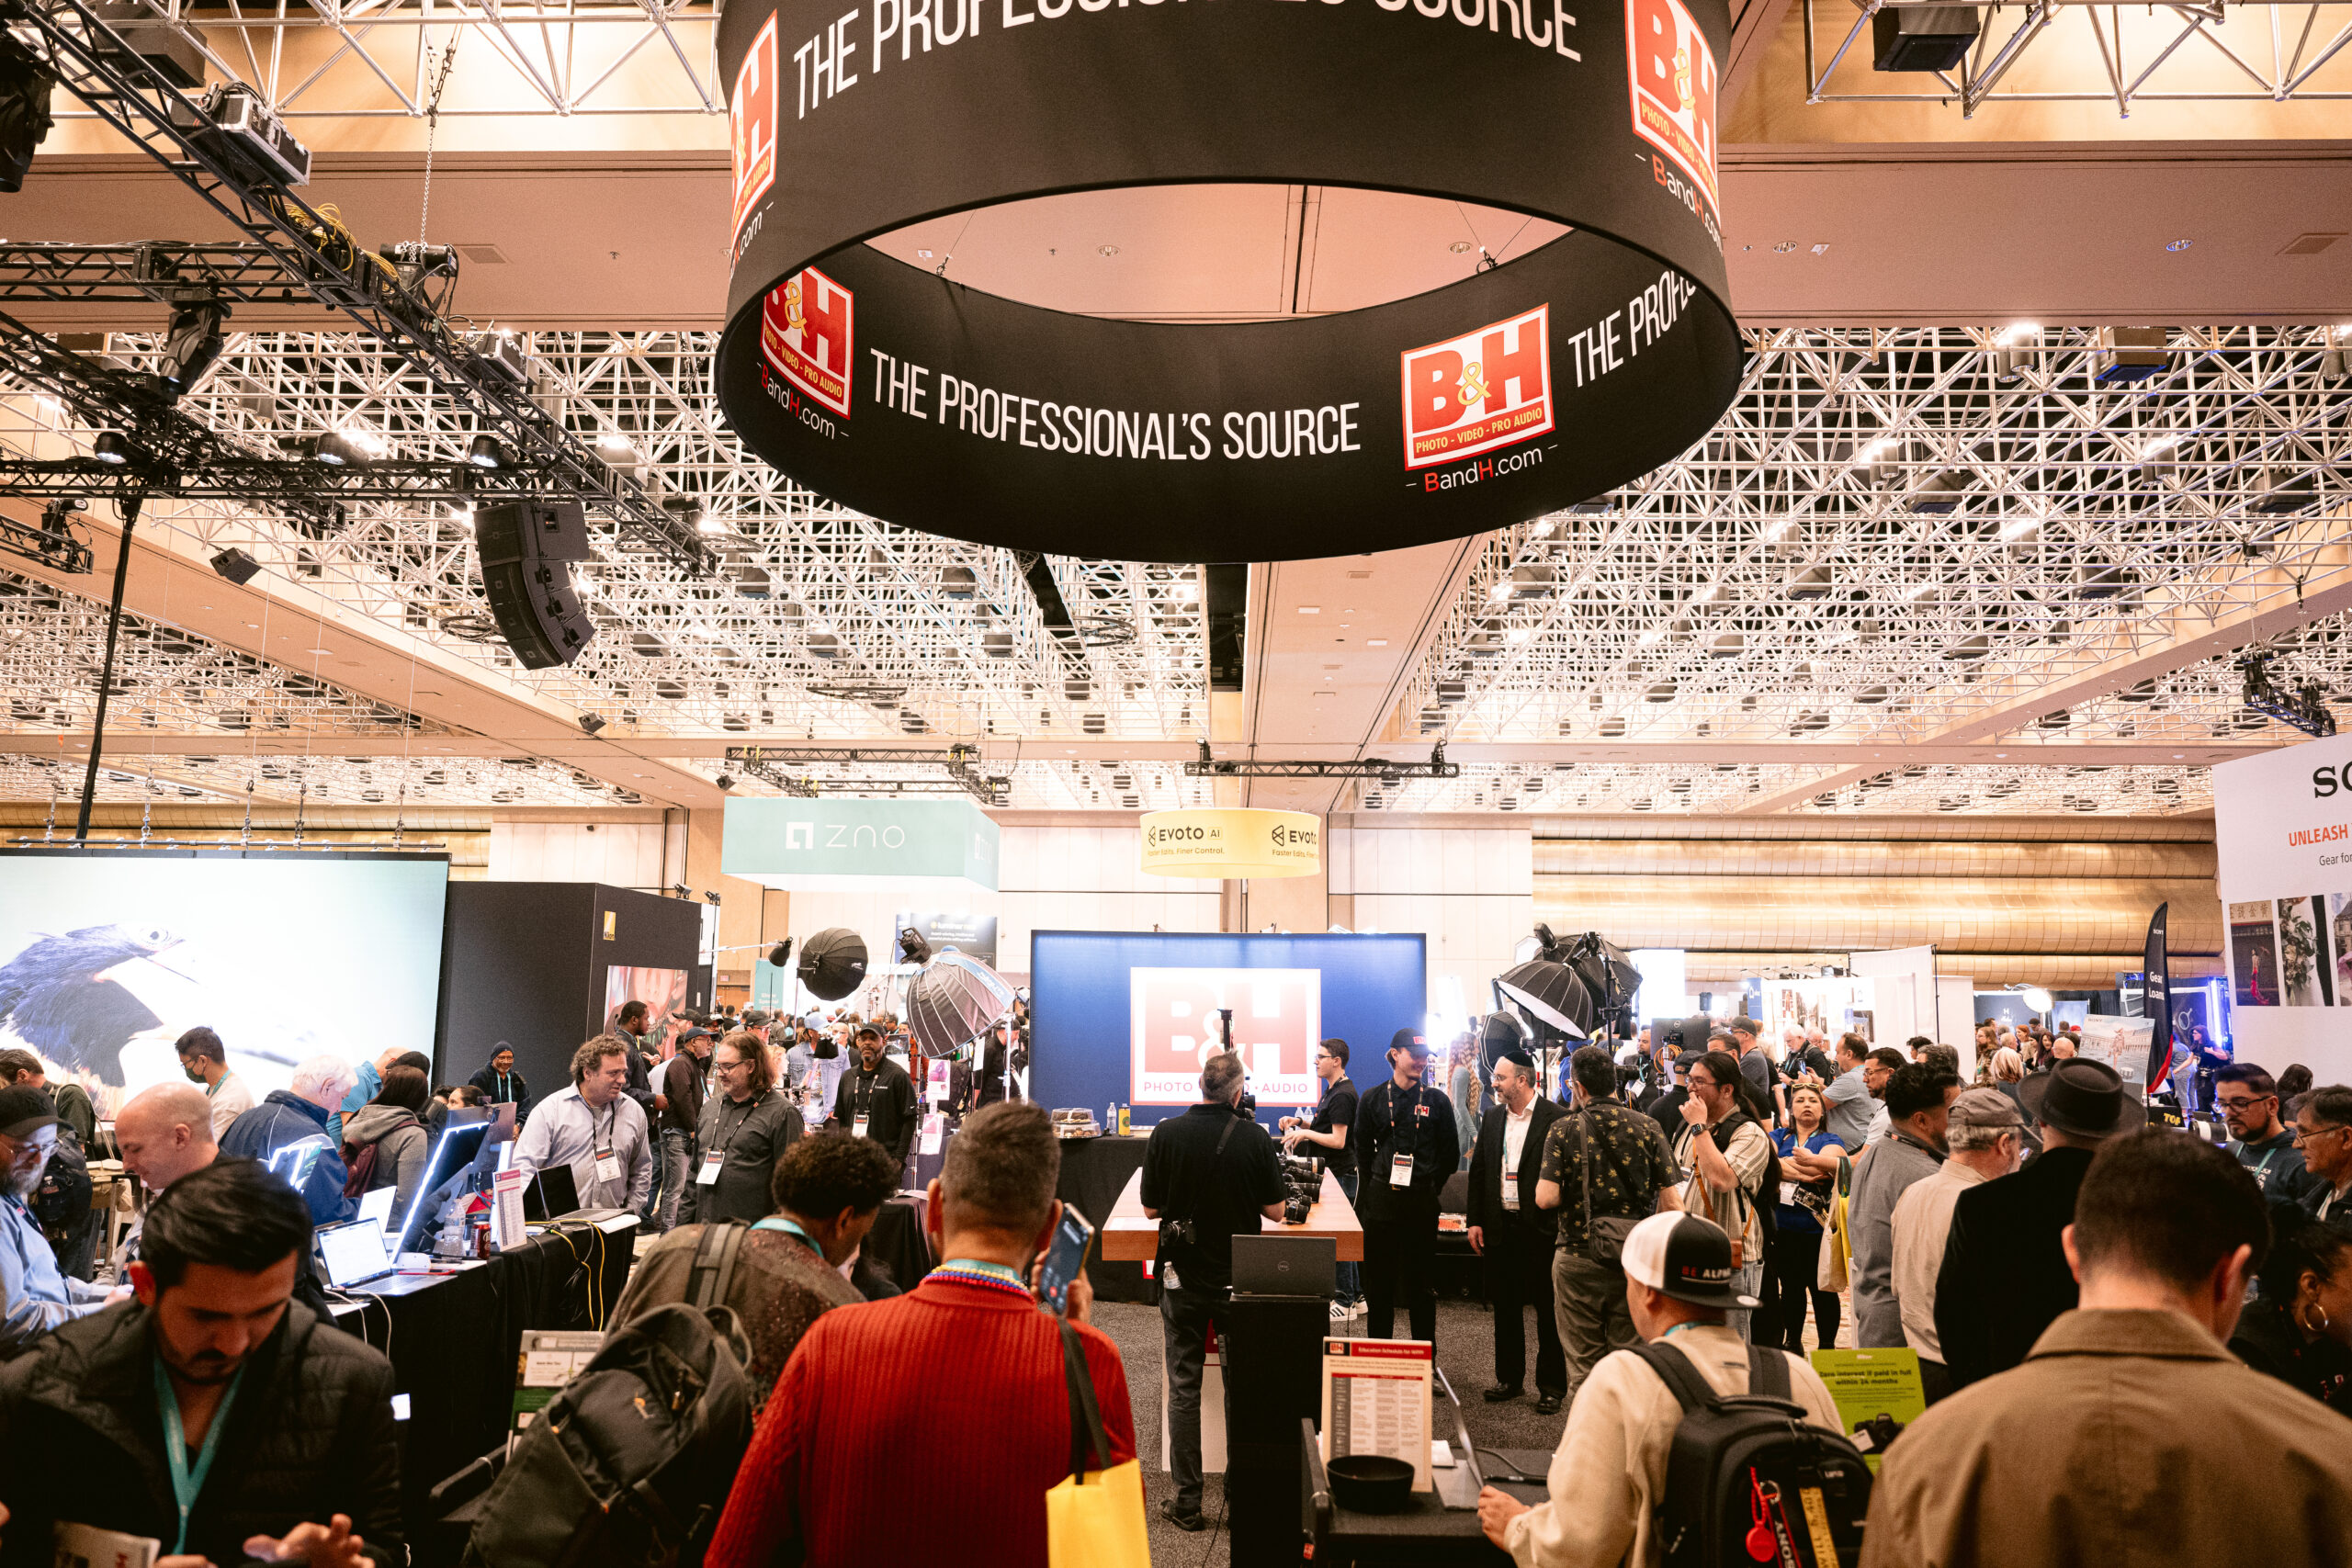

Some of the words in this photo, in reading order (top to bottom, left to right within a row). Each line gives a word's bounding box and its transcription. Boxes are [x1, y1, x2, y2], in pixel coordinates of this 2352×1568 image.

[794, 8, 859, 120] THE
[1633, 0, 1717, 176] B&H
[1641, 99, 1670, 136] PHOTO
[1676, 130, 1694, 164] VIDEO
[781, 344, 799, 370] VIDEO
[804, 365, 819, 384] PRO
[820, 379, 842, 399] AUDIO
[1410, 316, 1544, 434] B&H
[1567, 310, 1624, 388] THE
[762, 364, 835, 440] BandH.com
[870, 347, 929, 420] THE
[939, 373, 1211, 460] PROFESSIONAL'S
[1222, 402, 1362, 459] SOURCE
[1416, 435, 1449, 454] PHOTO
[1457, 427, 1484, 446] VIDEO
[1491, 418, 1511, 434] PRO
[1513, 408, 1543, 428] AUDIO
[1424, 447, 1543, 492] BandH.com
[1272, 849, 1293, 857] Faster
[2289, 824, 2348, 846] UNLEASH
[2319, 855, 2338, 866] Gear
[2150, 971, 2163, 984] Gear
[1145, 982, 1307, 1074] B&H
[1144, 1082, 1193, 1092] PHOTO
[1261, 1083, 1308, 1093] AUDIO
